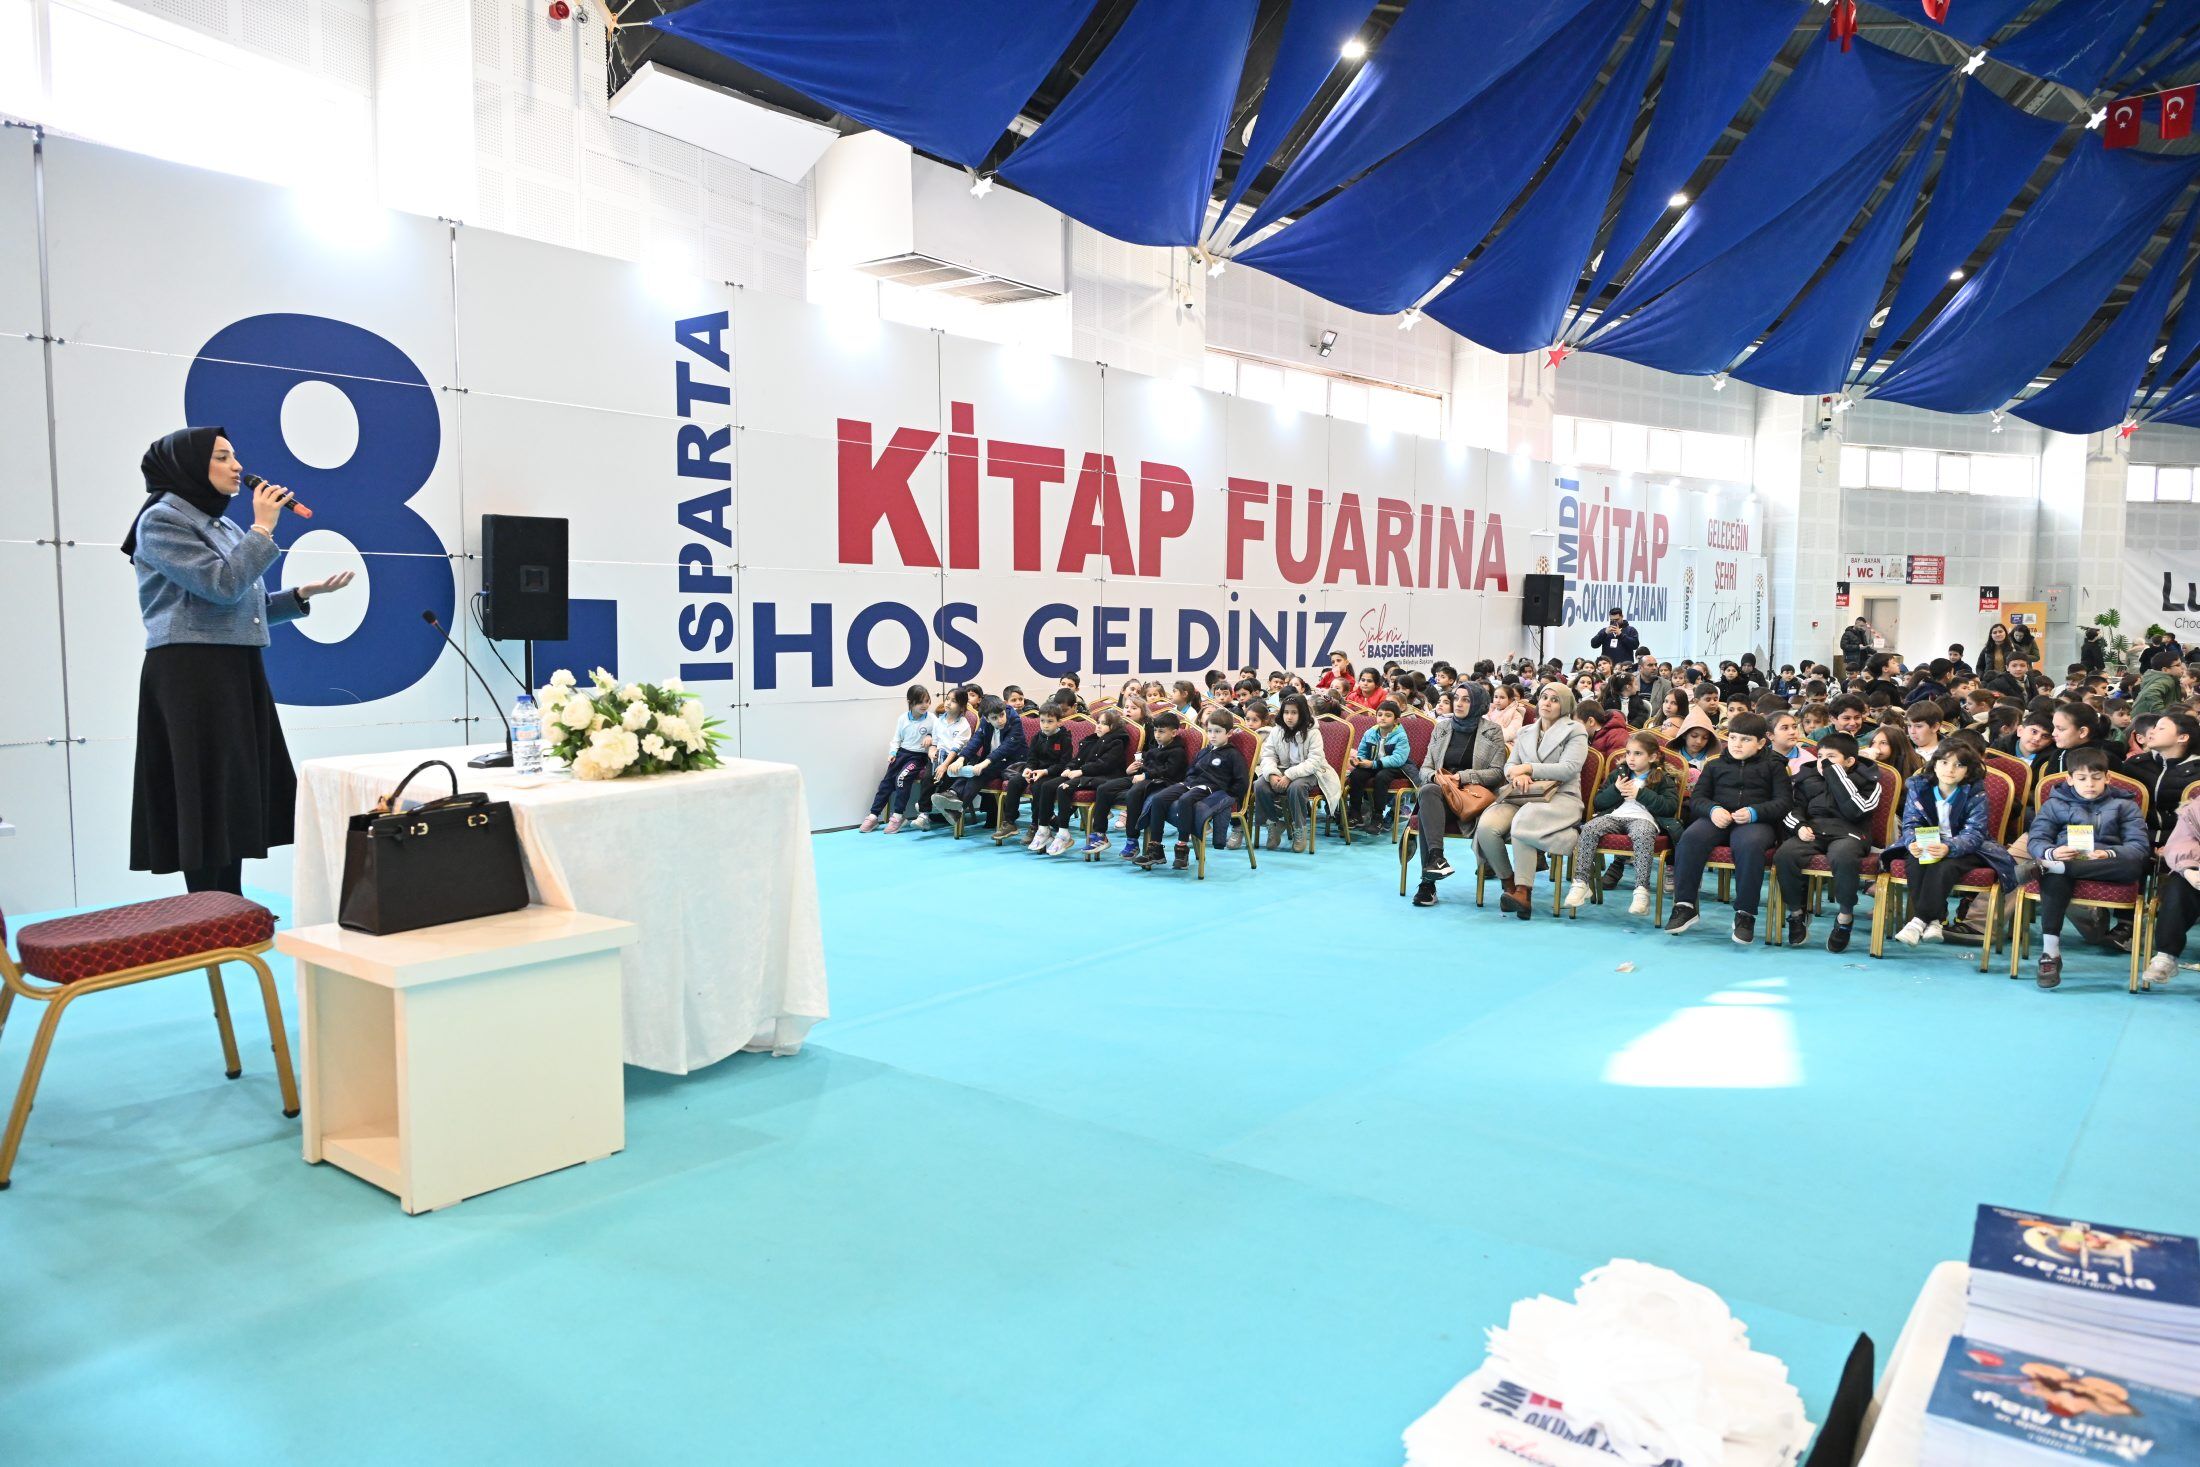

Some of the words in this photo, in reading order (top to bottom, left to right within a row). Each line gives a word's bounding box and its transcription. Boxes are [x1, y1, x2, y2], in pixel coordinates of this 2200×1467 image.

[675, 310, 734, 682] ISPARTA
[836, 400, 1195, 577] KİTAP
[1226, 476, 1509, 592] FUARINA
[1577, 486, 1670, 584] KİTAP
[1707, 517, 1749, 551] GELECEĞİN
[1714, 557, 1738, 595] ŞEHRİ
[1857, 567, 1874, 578] WC
[1582, 582, 1623, 622] OKUMA
[1626, 585, 1668, 622] ZAMANI
[1022, 591, 1348, 679] GELDİNİZ
[1367, 640, 1434, 660] BAŞDEĞİRMEN
